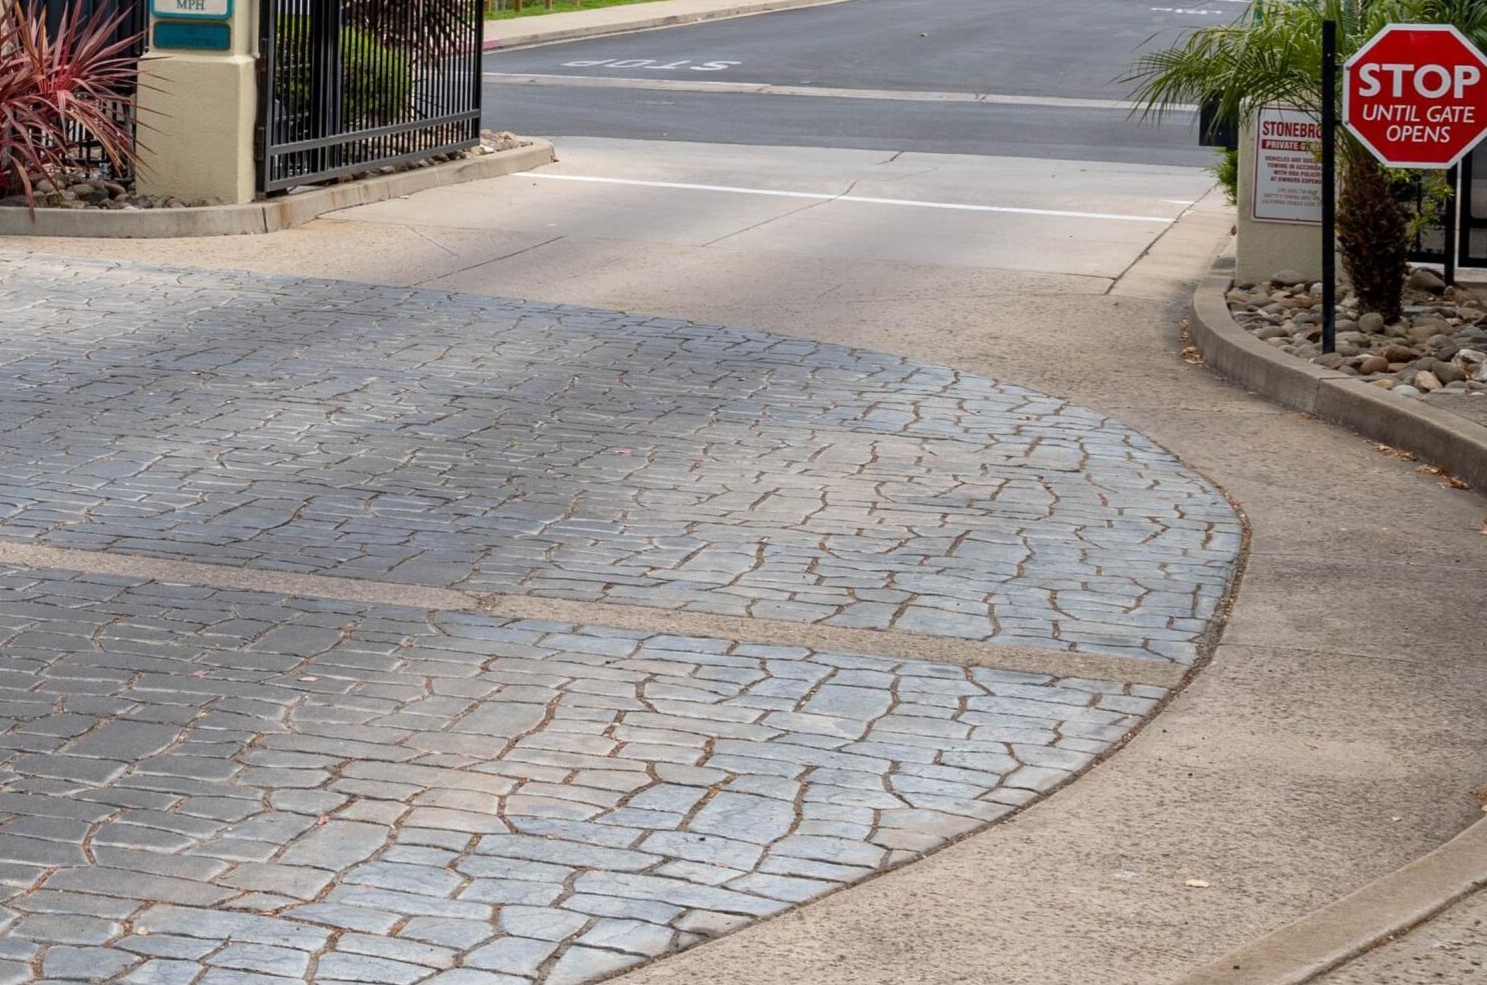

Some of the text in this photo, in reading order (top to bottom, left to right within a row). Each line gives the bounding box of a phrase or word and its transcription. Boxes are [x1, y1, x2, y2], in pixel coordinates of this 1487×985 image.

[562, 58, 742, 71] STOP
[1358, 62, 1481, 99] STOP
[1362, 104, 1475, 123] UNTIL GATE
[1262, 120, 1322, 139] STONEBRO
[1386, 124, 1451, 143] OPENS
[1265, 141, 1298, 150] PRIVATE
